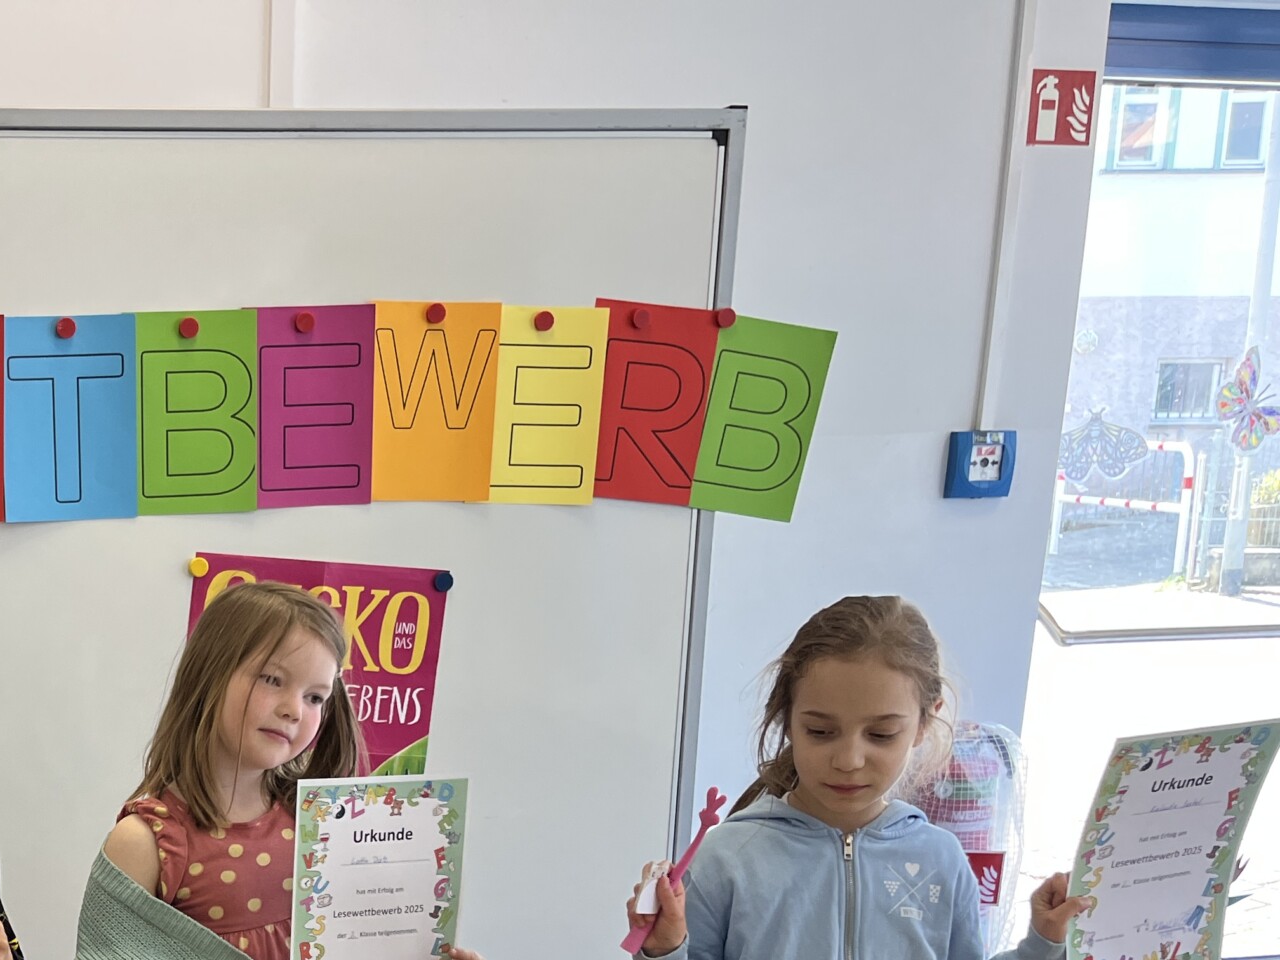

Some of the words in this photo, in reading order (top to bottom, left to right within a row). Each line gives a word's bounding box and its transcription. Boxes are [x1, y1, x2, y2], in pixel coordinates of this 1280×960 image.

[395, 622, 415, 635] UND
[394, 637, 412, 649] DAS
[1151, 773, 1213, 793] Urkunde
[353, 827, 413, 843] Urkunde
[1111, 850, 1180, 868] Lesewettbewerb
[1182, 846, 1203, 856] 2025
[333, 907, 402, 918] Lesewettbewerb
[404, 905, 424, 914] 2025
